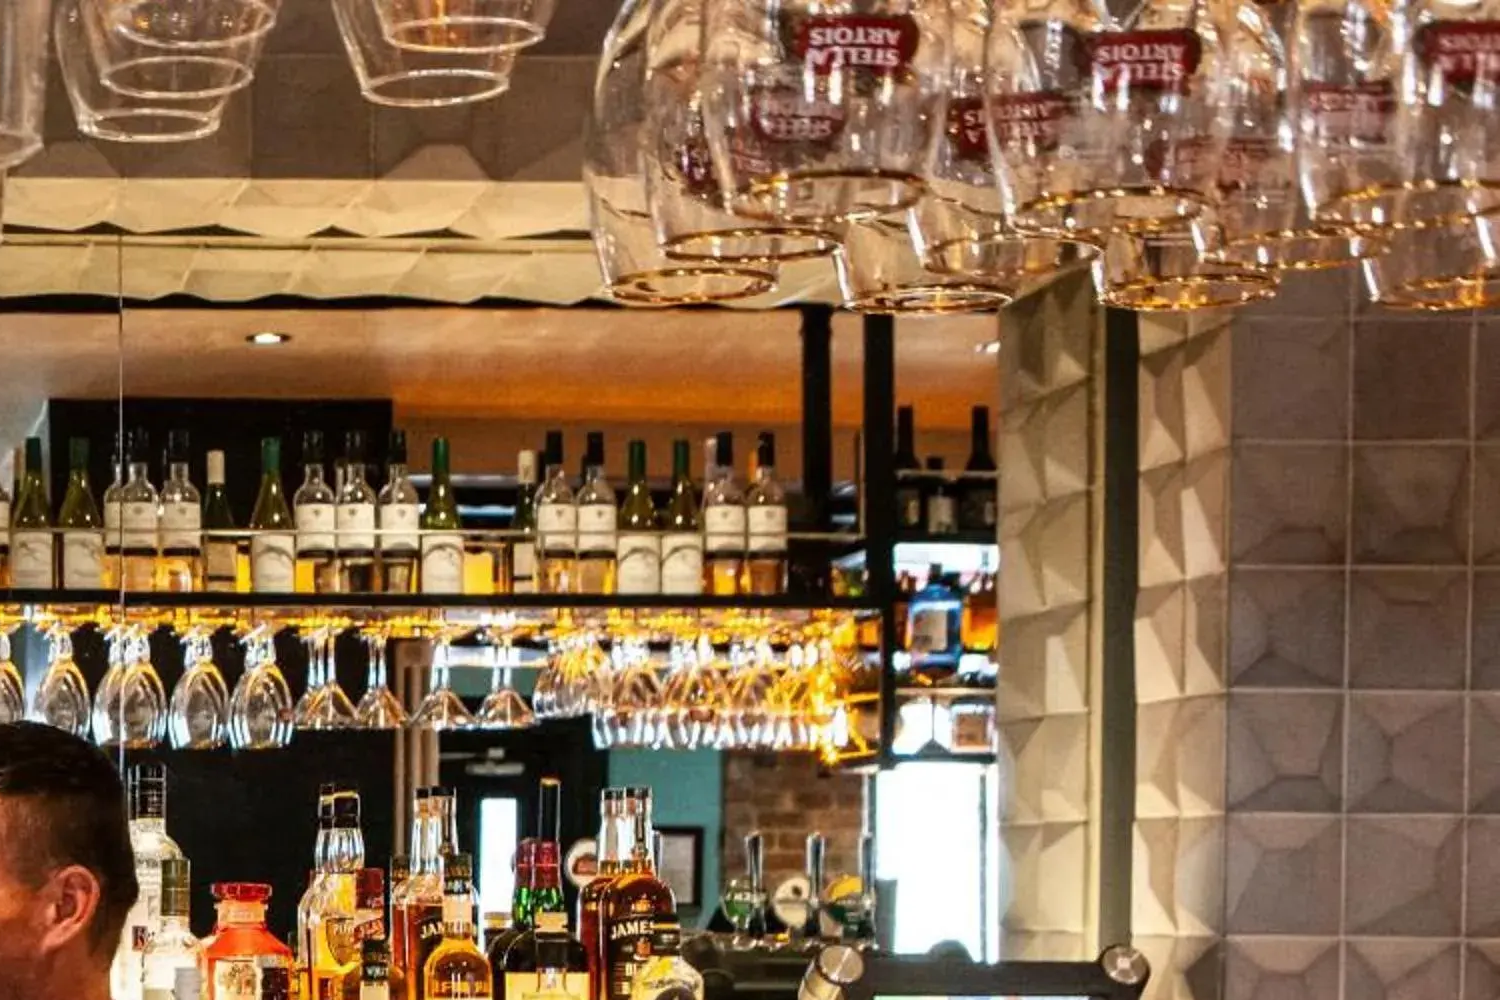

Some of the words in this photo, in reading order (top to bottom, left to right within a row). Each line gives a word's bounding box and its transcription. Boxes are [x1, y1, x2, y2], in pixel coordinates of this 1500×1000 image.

[807, 26, 901, 46] ARTOIS
[806, 46, 901, 68] STELLA
[1101, 44, 1188, 63] ARTOIS
[610, 921, 654, 940] JAME
